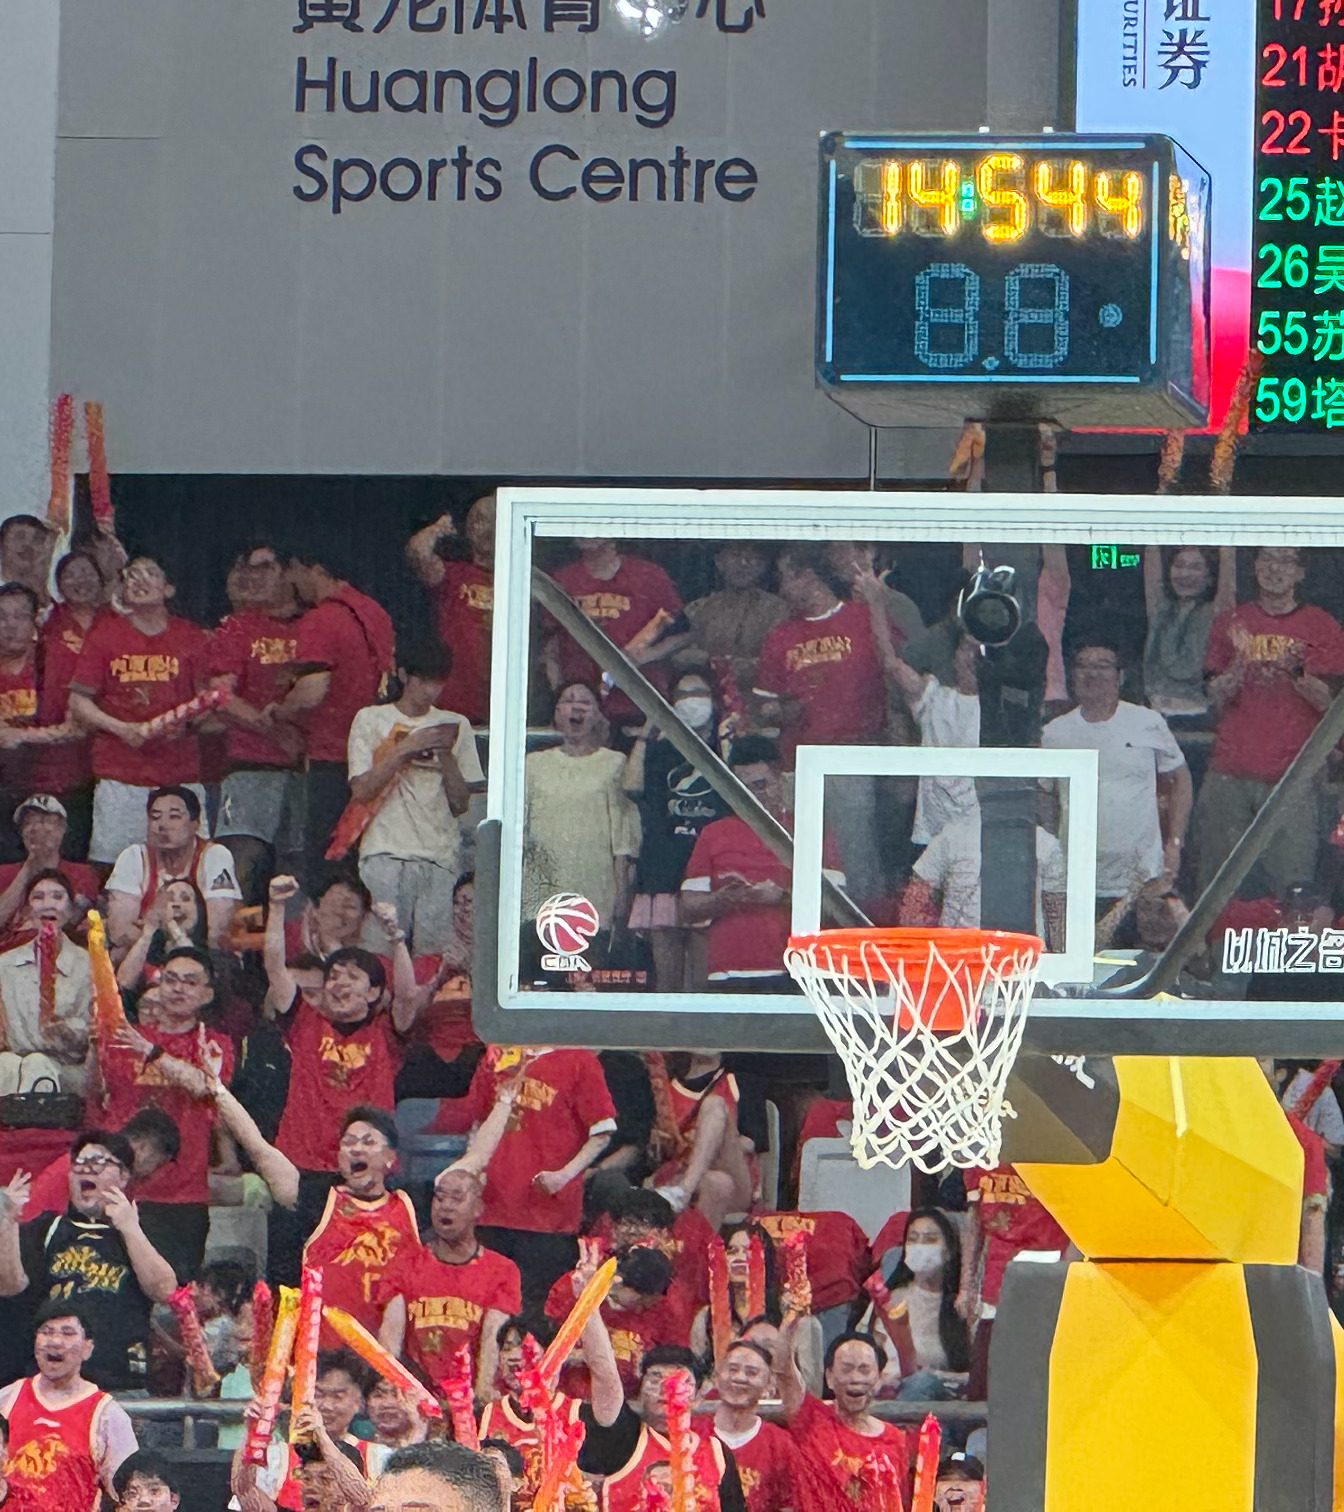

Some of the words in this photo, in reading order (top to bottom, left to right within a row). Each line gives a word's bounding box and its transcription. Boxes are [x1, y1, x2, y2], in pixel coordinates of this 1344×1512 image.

[294, 56, 678, 129] Huanglong
[292, 144, 503, 216] Sports
[529, 144, 759, 203] Centre
